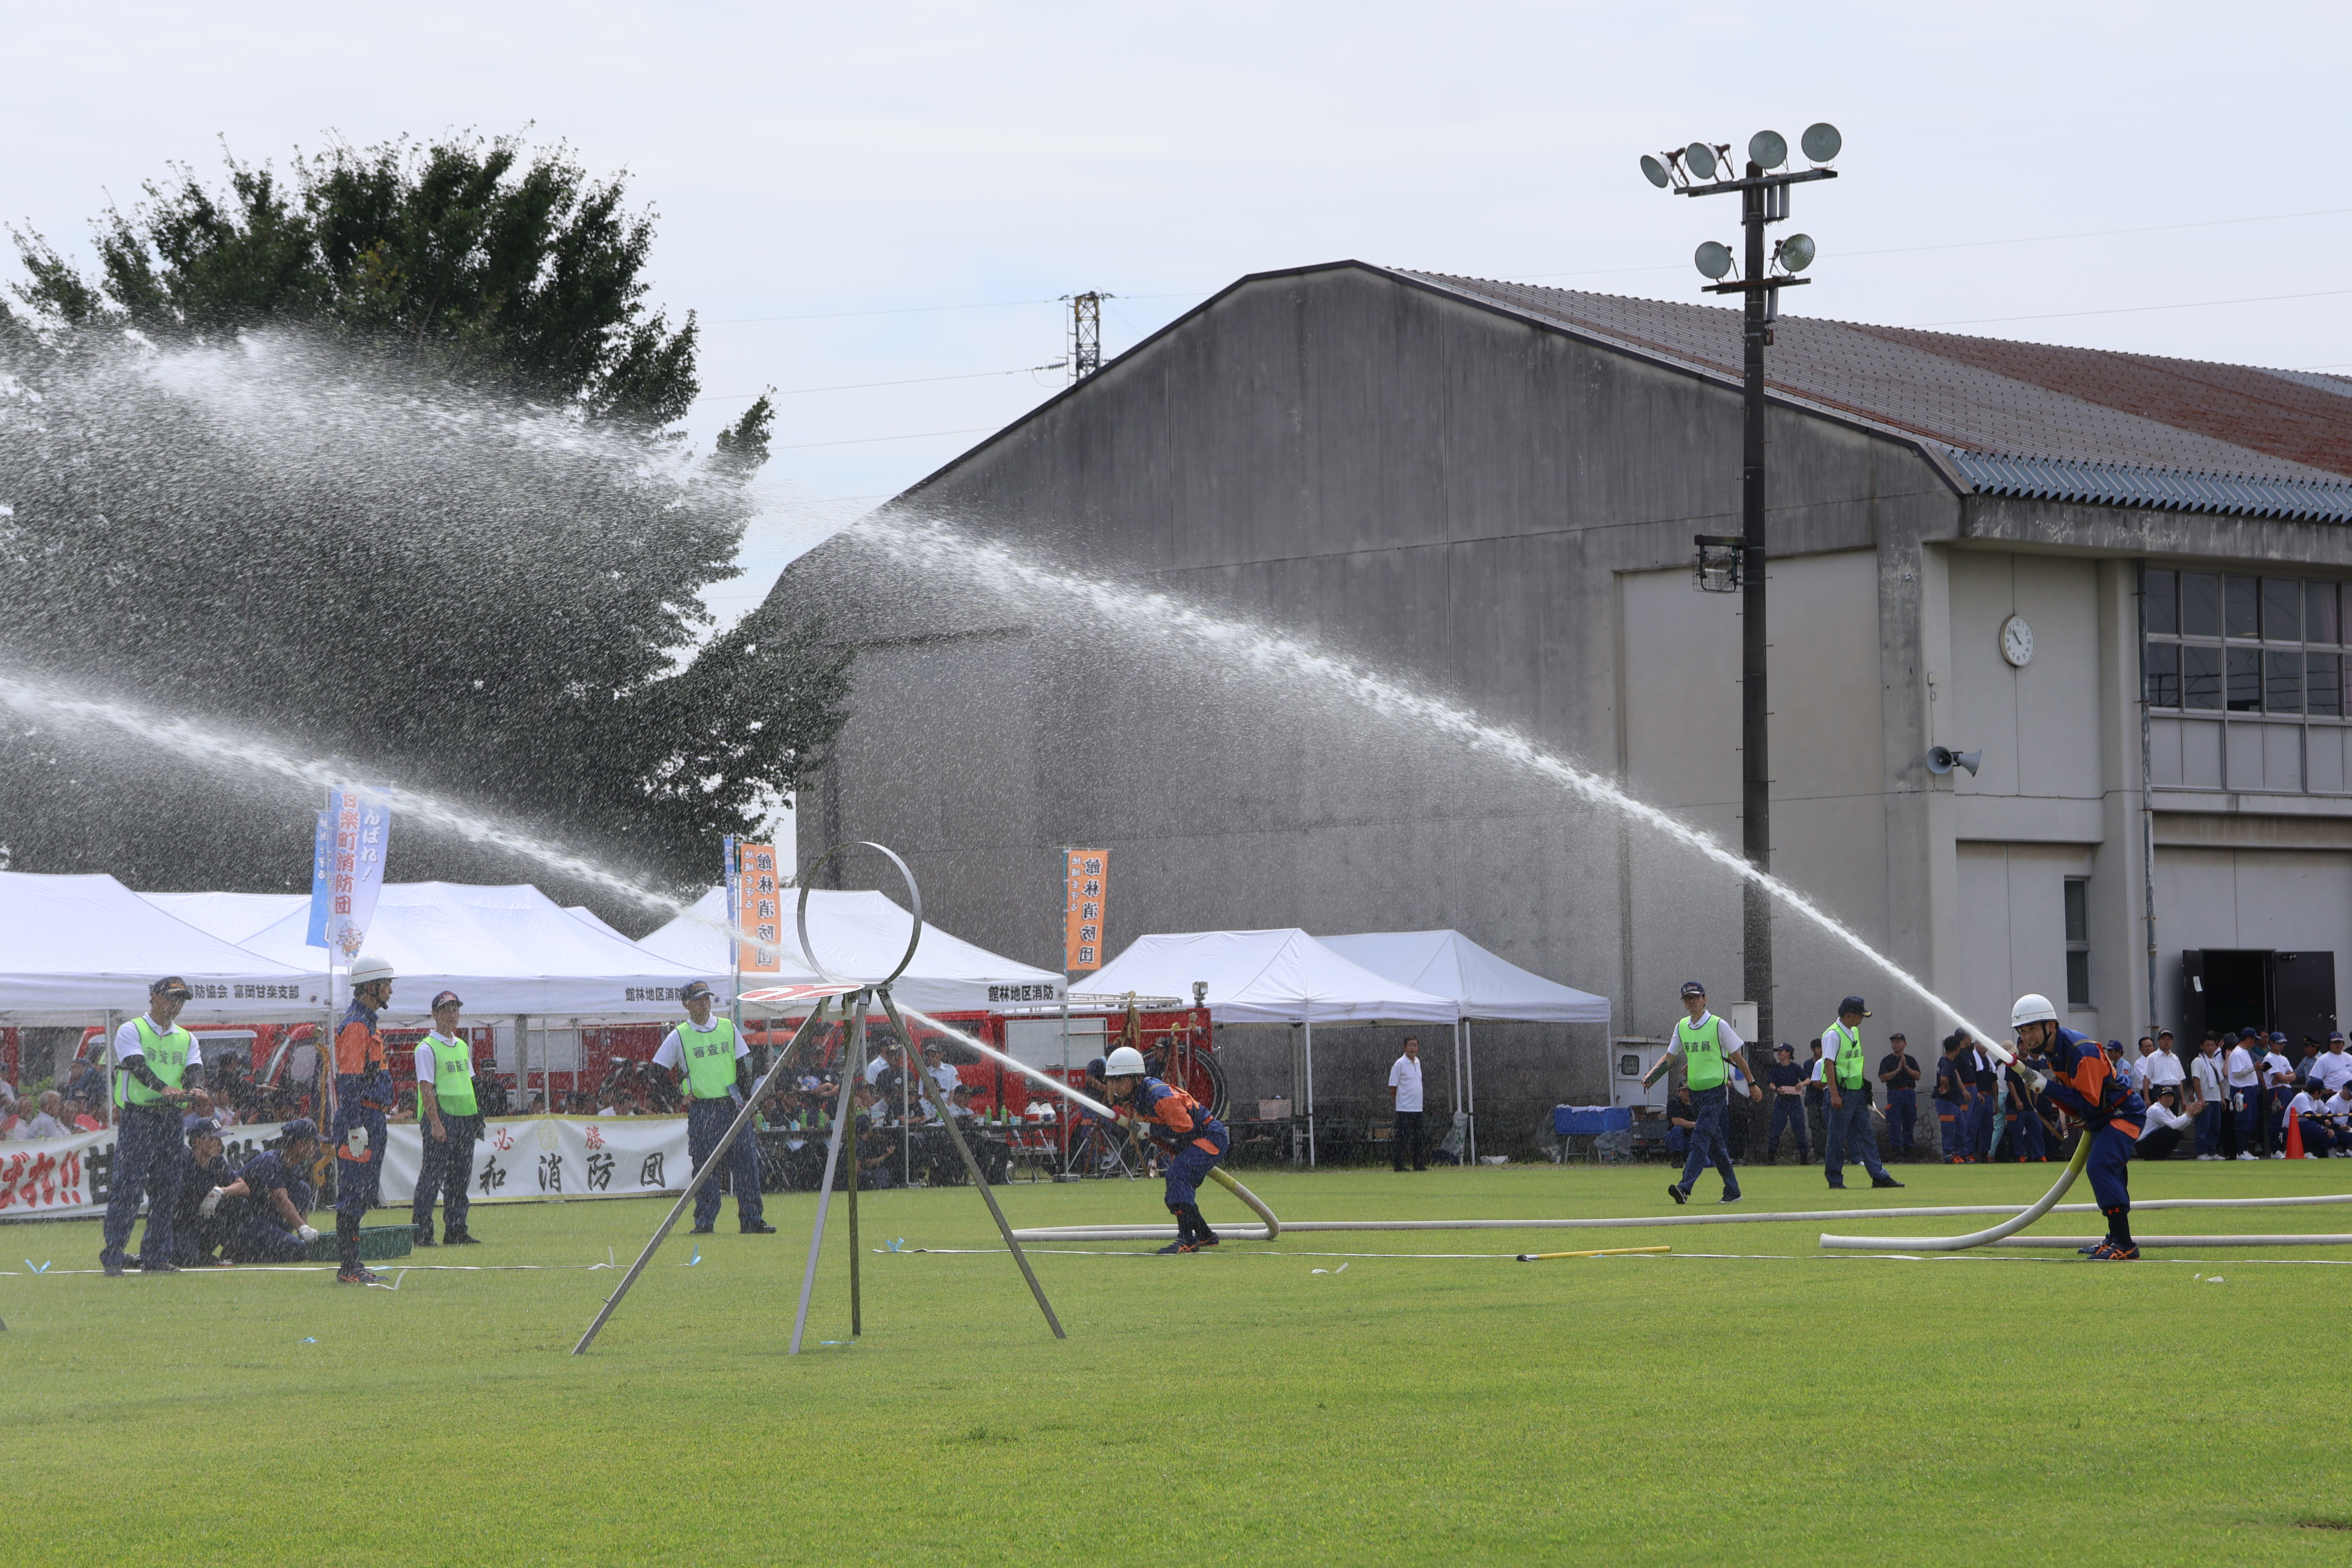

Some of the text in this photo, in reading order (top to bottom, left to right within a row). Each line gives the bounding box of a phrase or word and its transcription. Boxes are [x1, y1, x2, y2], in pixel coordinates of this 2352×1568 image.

[234, 985, 299, 999] 富岡甘楽支部
[988, 984, 1054, 1002] 館林地区消防
[693, 1041, 730, 1058] 審査員
[1684, 1041, 1711, 1052] 審査員
[1846, 1049, 1863, 1059] 審査
[147, 1047, 183, 1065] 審査員
